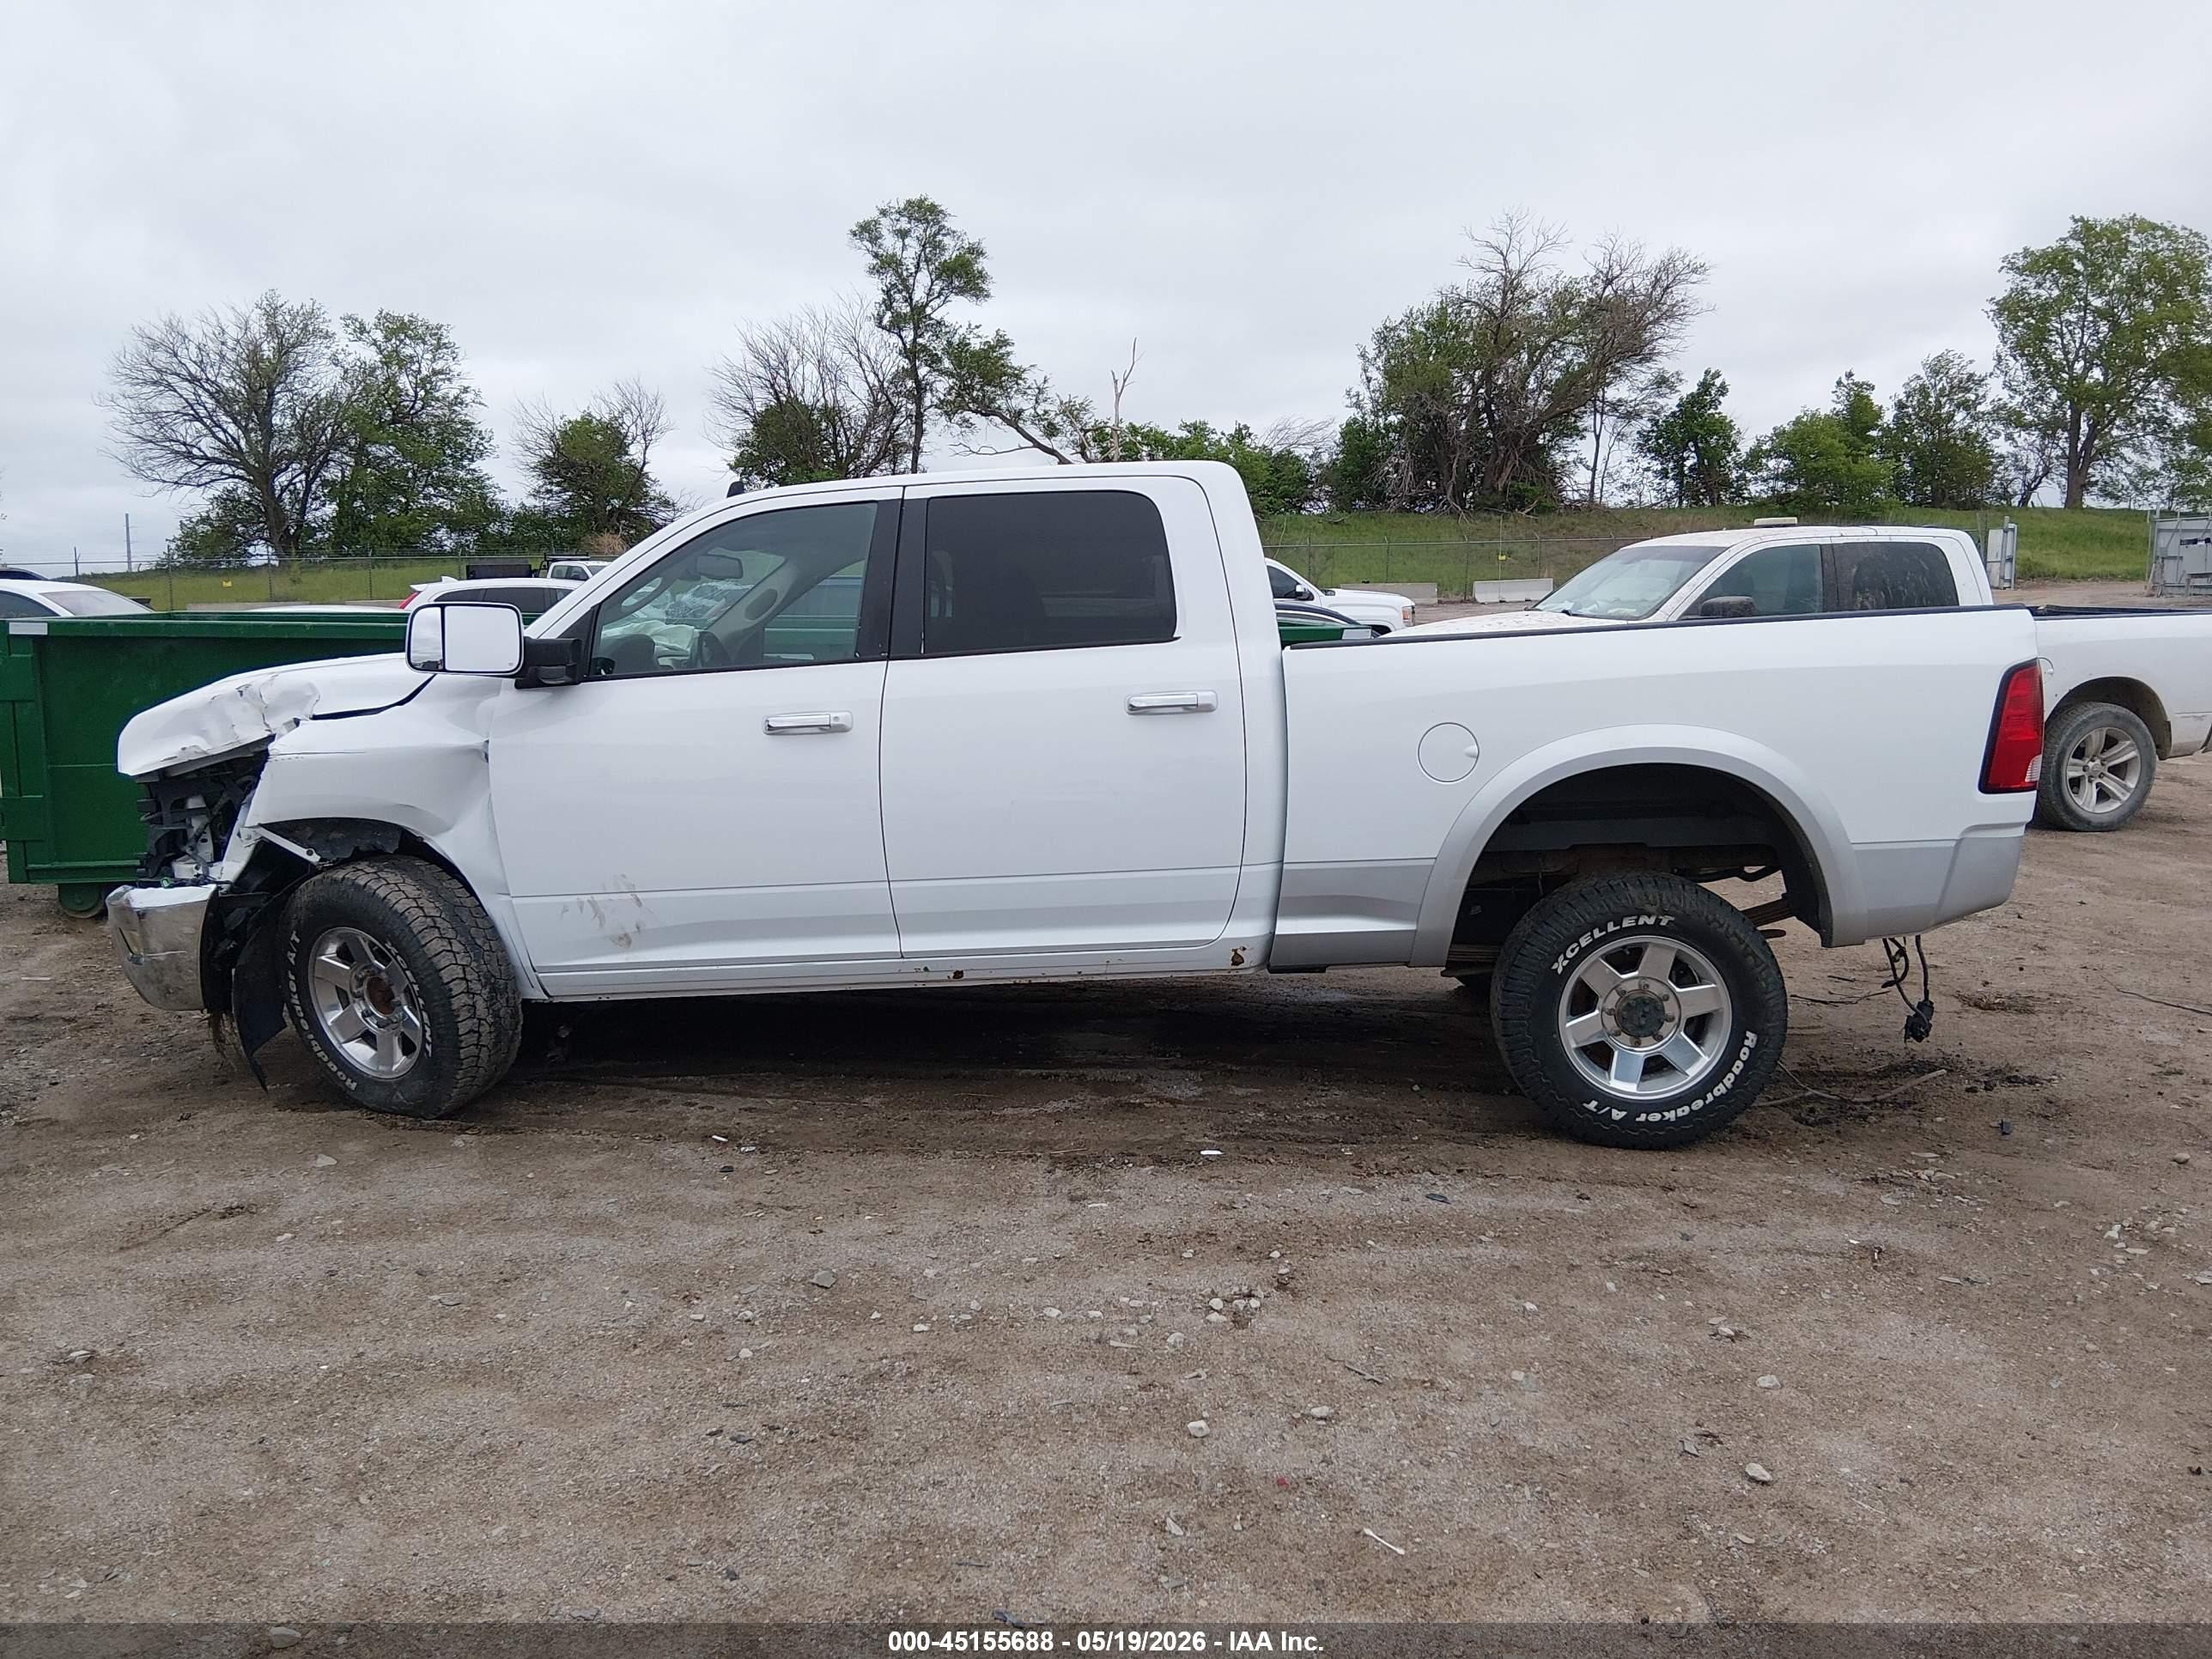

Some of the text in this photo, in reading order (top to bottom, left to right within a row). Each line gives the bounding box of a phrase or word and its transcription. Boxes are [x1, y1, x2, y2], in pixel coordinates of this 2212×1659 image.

[287, 931, 301, 966] A/T
[1551, 915, 1675, 975] XCELLENT
[1582, 1030, 1759, 1122] Roadbreaker A/T
